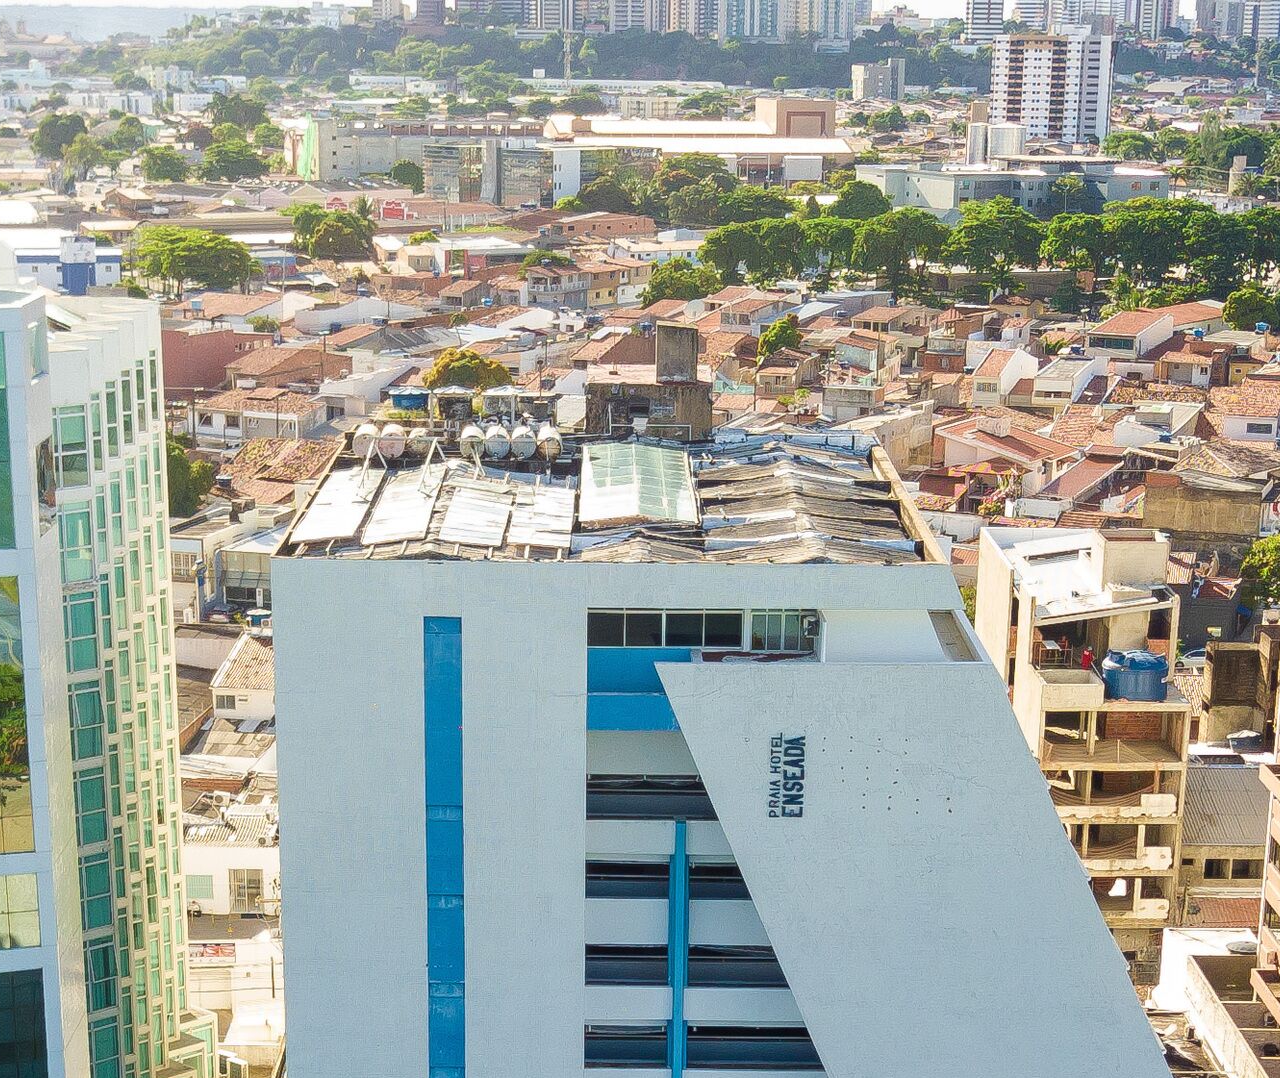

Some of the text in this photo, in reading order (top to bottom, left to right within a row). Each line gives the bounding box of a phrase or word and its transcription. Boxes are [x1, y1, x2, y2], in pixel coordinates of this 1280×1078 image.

[769, 732, 783, 818] PRAIA HOTEL
[782, 736, 806, 818] ENSEADA
